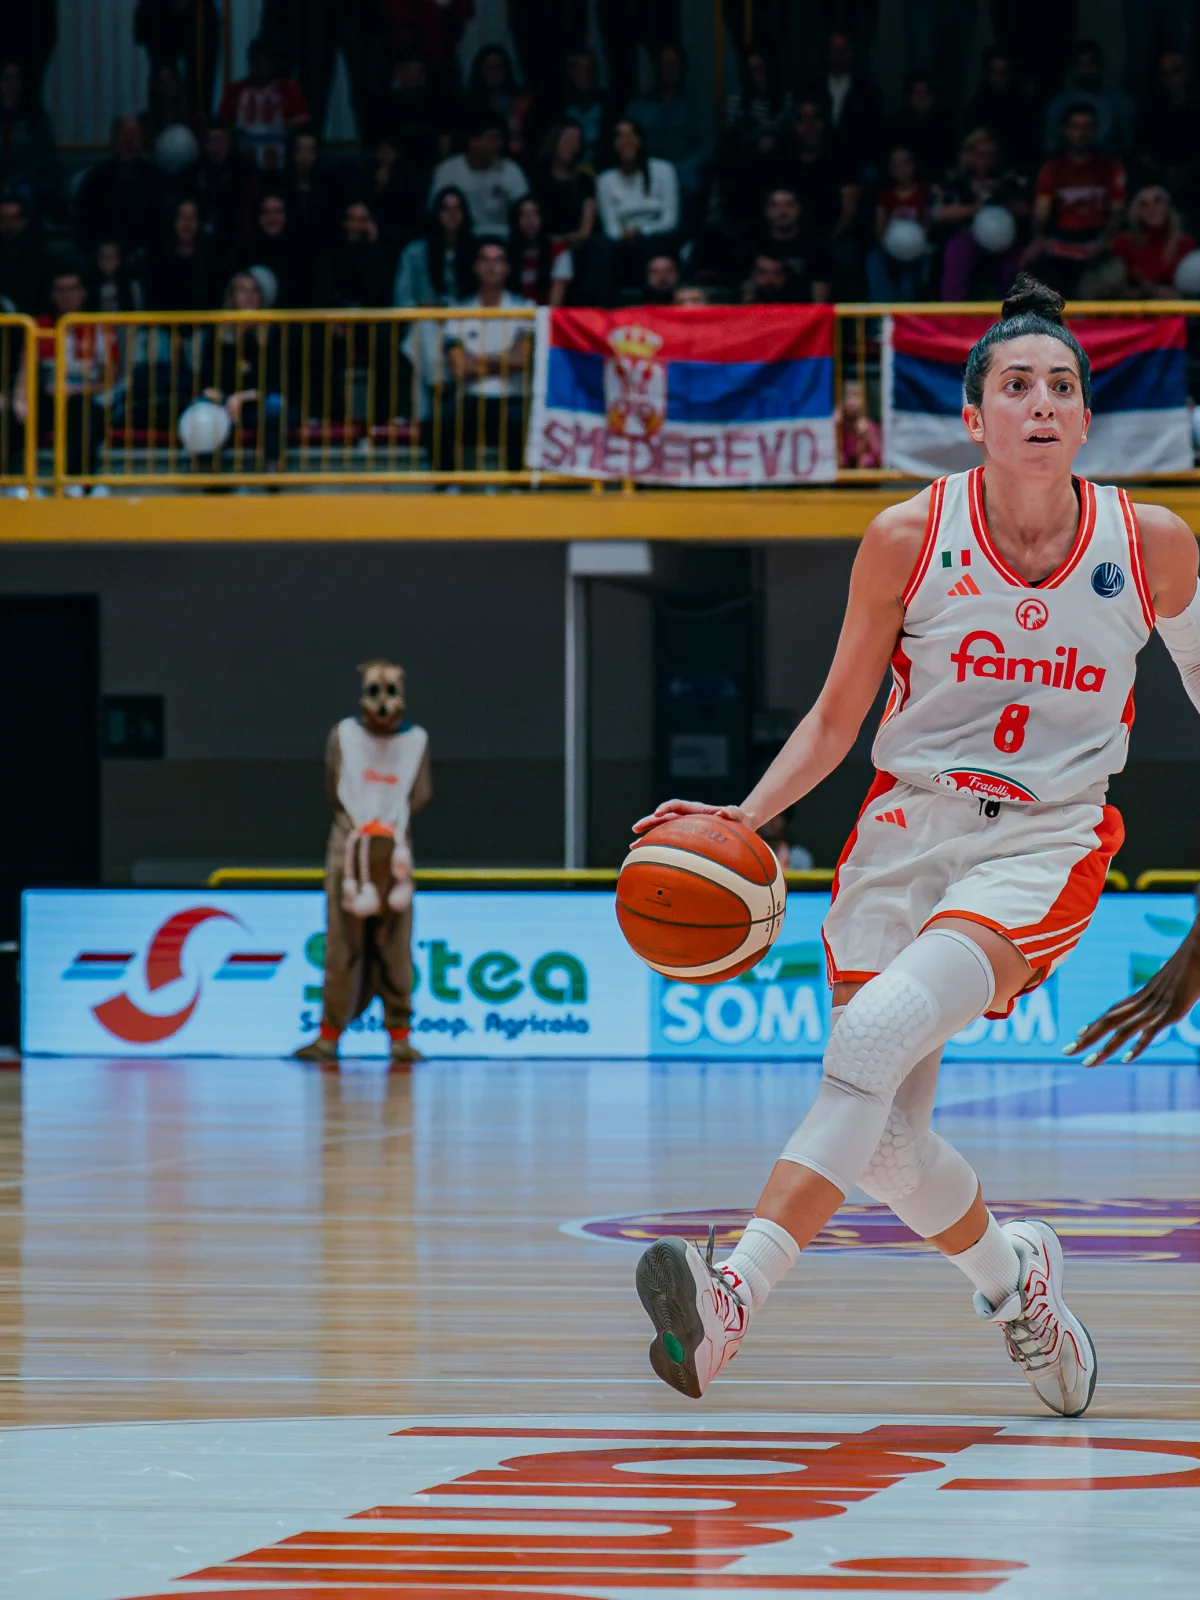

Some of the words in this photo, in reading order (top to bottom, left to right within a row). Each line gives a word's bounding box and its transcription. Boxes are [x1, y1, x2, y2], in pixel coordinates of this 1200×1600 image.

[541, 420, 819, 479] SMEDEREVO
[950, 630, 1107, 693] famila
[993, 703, 1030, 753] 8
[968, 775, 1010, 797] Fratelli
[662, 984, 823, 1045] SOM
